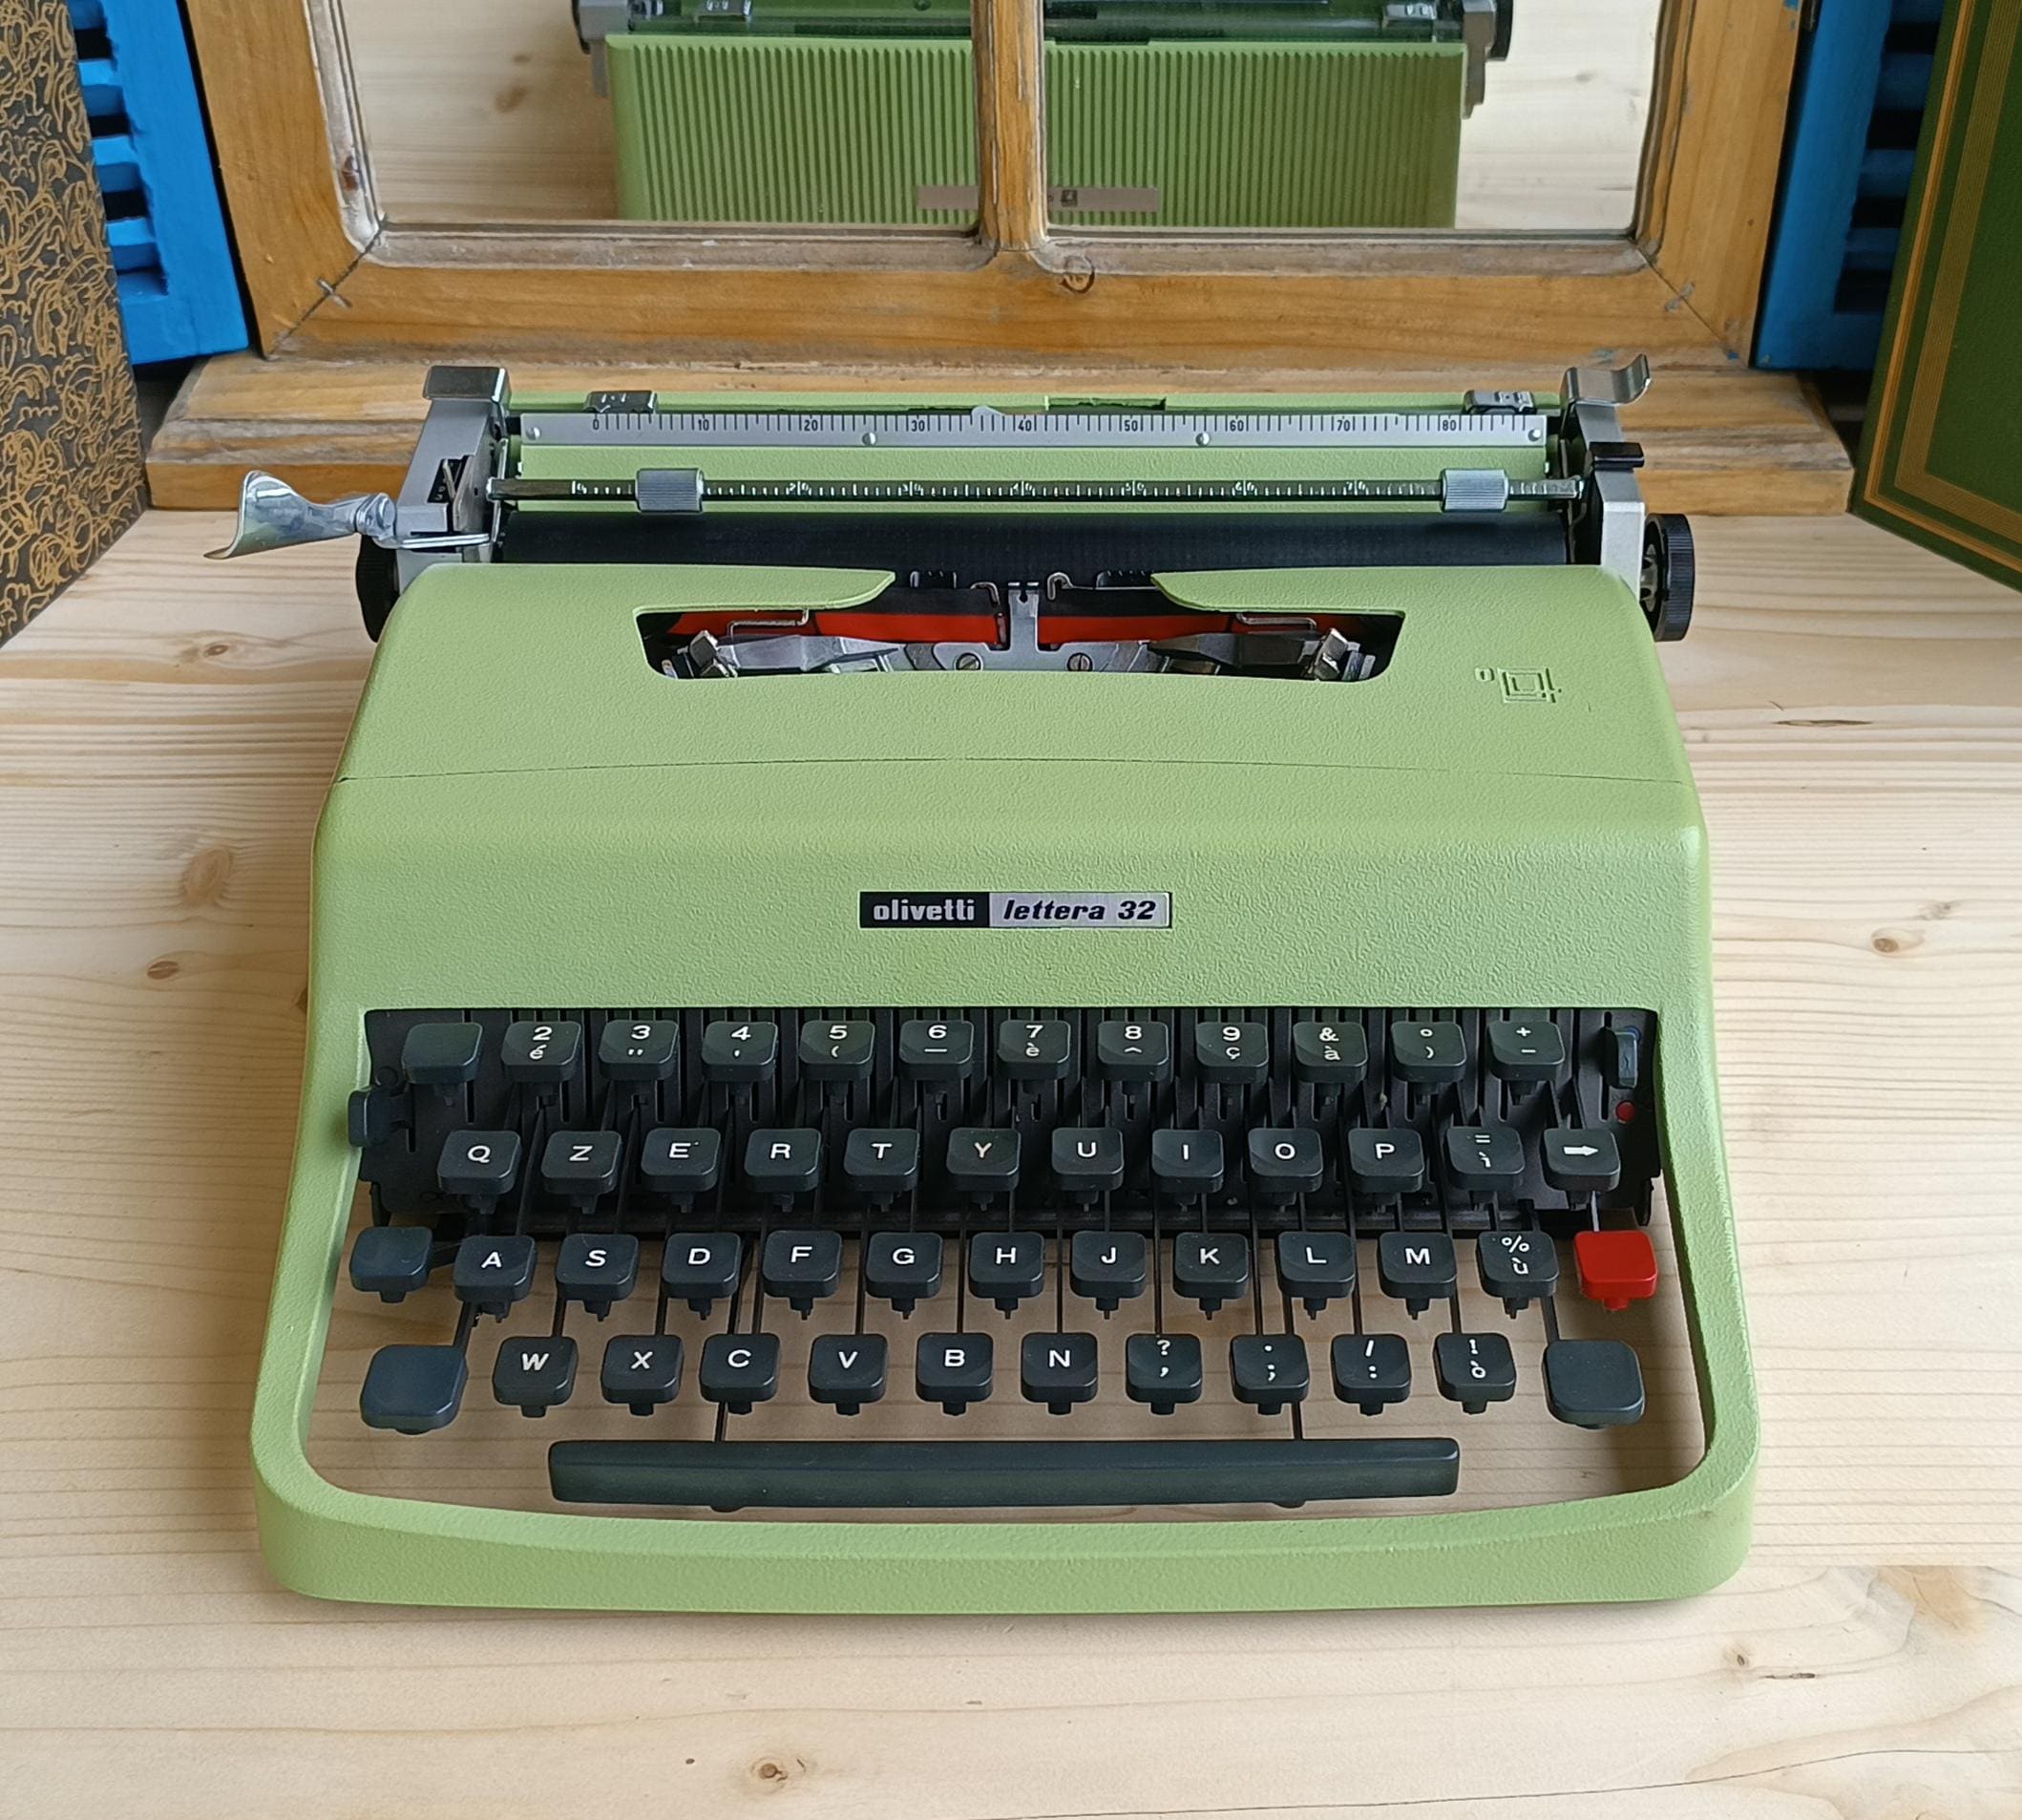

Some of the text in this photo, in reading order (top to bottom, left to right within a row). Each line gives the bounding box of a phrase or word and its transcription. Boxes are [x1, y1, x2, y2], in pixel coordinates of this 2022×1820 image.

[592, 418, 1457, 432] 0 10 20 30 40 50 60 70 80
[873, 898, 1156, 921] olivetti lettera 32
[532, 1026, 553, 1041] 2
[631, 1025, 651, 1040] 3
[731, 1026, 751, 1041] 4
[829, 1025, 848, 1040] 5
[928, 1025, 947, 1039] 6
[1025, 1025, 1043, 1039] 7
[1125, 1026, 1142, 1040] 8
[1222, 1026, 1241, 1042] 9
[1318, 1026, 1339, 1042] &
[1516, 1026, 1531, 1037] +
[529, 1044, 547, 1060] é
[1025, 1042, 1040, 1057] è
[1226, 1047, 1241, 1060] ç
[1324, 1045, 1340, 1061] à
[1475, 1134, 1491, 1143] =
[467, 1145, 491, 1163] Q
[569, 1145, 593, 1161] Z
[668, 1142, 691, 1158] E
[770, 1143, 791, 1159] R
[872, 1143, 893, 1159] T
[974, 1142, 992, 1158] Y
[1077, 1141, 1097, 1157] U
[1274, 1143, 1295, 1159] O
[1375, 1143, 1395, 1159] P
[1501, 1235, 1530, 1254] %
[481, 1251, 502, 1269] A
[585, 1249, 607, 1267] S
[687, 1248, 711, 1265] D
[790, 1246, 812, 1263] F
[892, 1248, 915, 1265] G
[996, 1247, 1017, 1264] H
[1101, 1247, 1116, 1264] J
[1200, 1248, 1220, 1264] K
[1306, 1246, 1327, 1264] L
[1404, 1247, 1430, 1265] M
[1511, 1257, 1528, 1275] ù
[1157, 1339, 1170, 1356] ?
[1469, 1339, 1479, 1355] !
[521, 1353, 550, 1371] W
[631, 1351, 653, 1369] X
[727, 1349, 751, 1368] C
[838, 1351, 858, 1369] V
[944, 1349, 965, 1367] B
[1049, 1349, 1070, 1367] N
[1267, 1364, 1276, 1382] ;
[1368, 1365, 1378, 1379] :
[1470, 1360, 1486, 1379] ò
